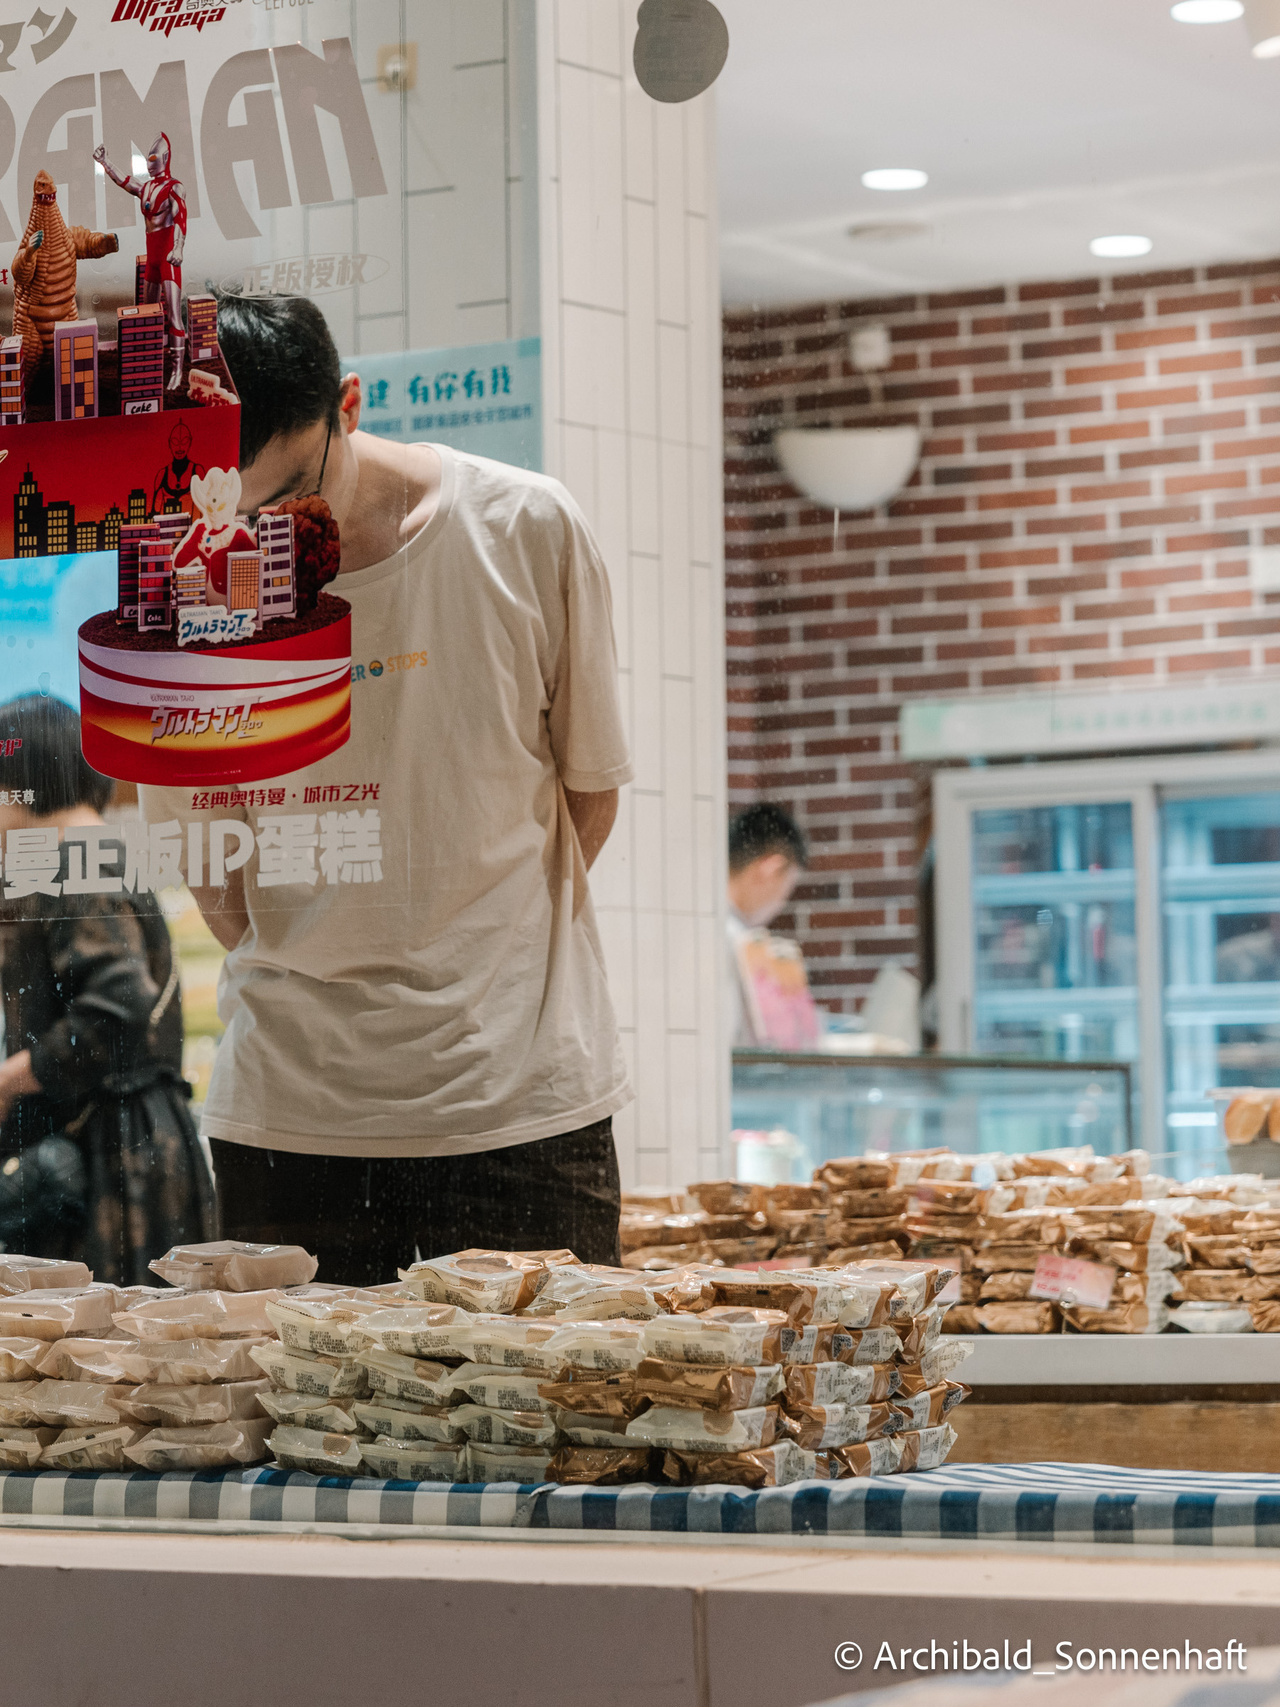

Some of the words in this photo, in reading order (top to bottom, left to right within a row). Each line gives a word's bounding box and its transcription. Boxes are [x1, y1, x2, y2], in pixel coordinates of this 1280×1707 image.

[239, 253, 368, 297] 正版授权
[387, 651, 428, 673] STOPS
